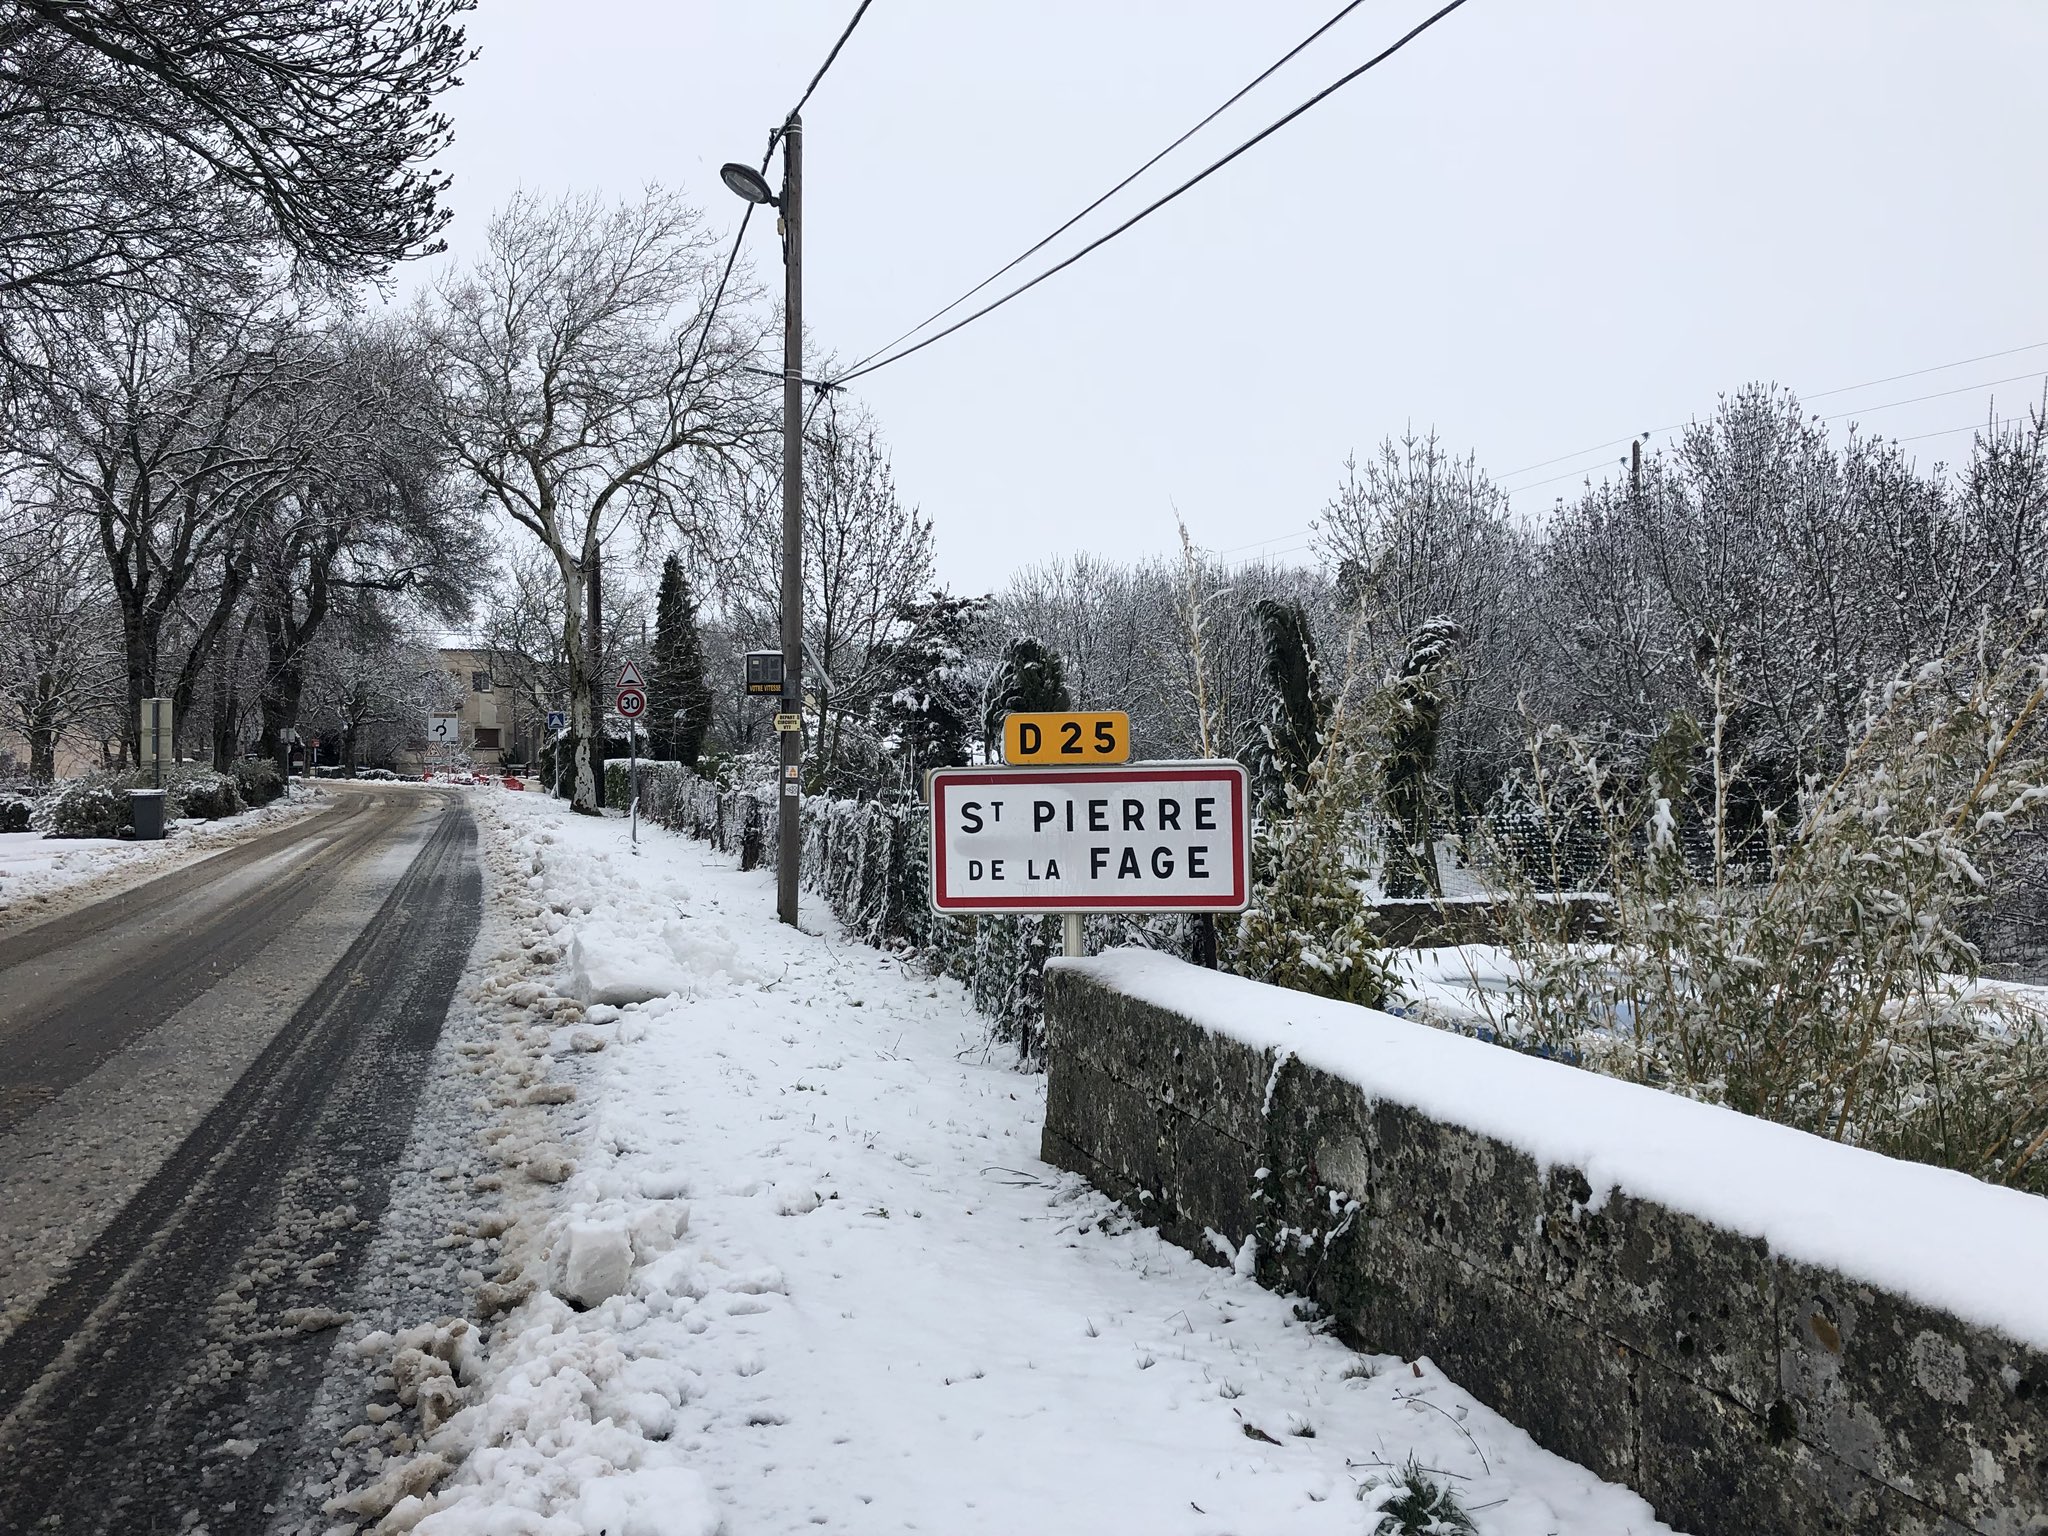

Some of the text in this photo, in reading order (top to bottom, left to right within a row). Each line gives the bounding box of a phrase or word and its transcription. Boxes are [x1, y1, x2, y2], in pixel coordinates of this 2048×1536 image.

[622, 696, 640, 710] 30
[1019, 721, 1116, 755] D 25
[1033, 797, 1217, 832] PIERRE
[969, 846, 1210, 881] DE LA FAGE
